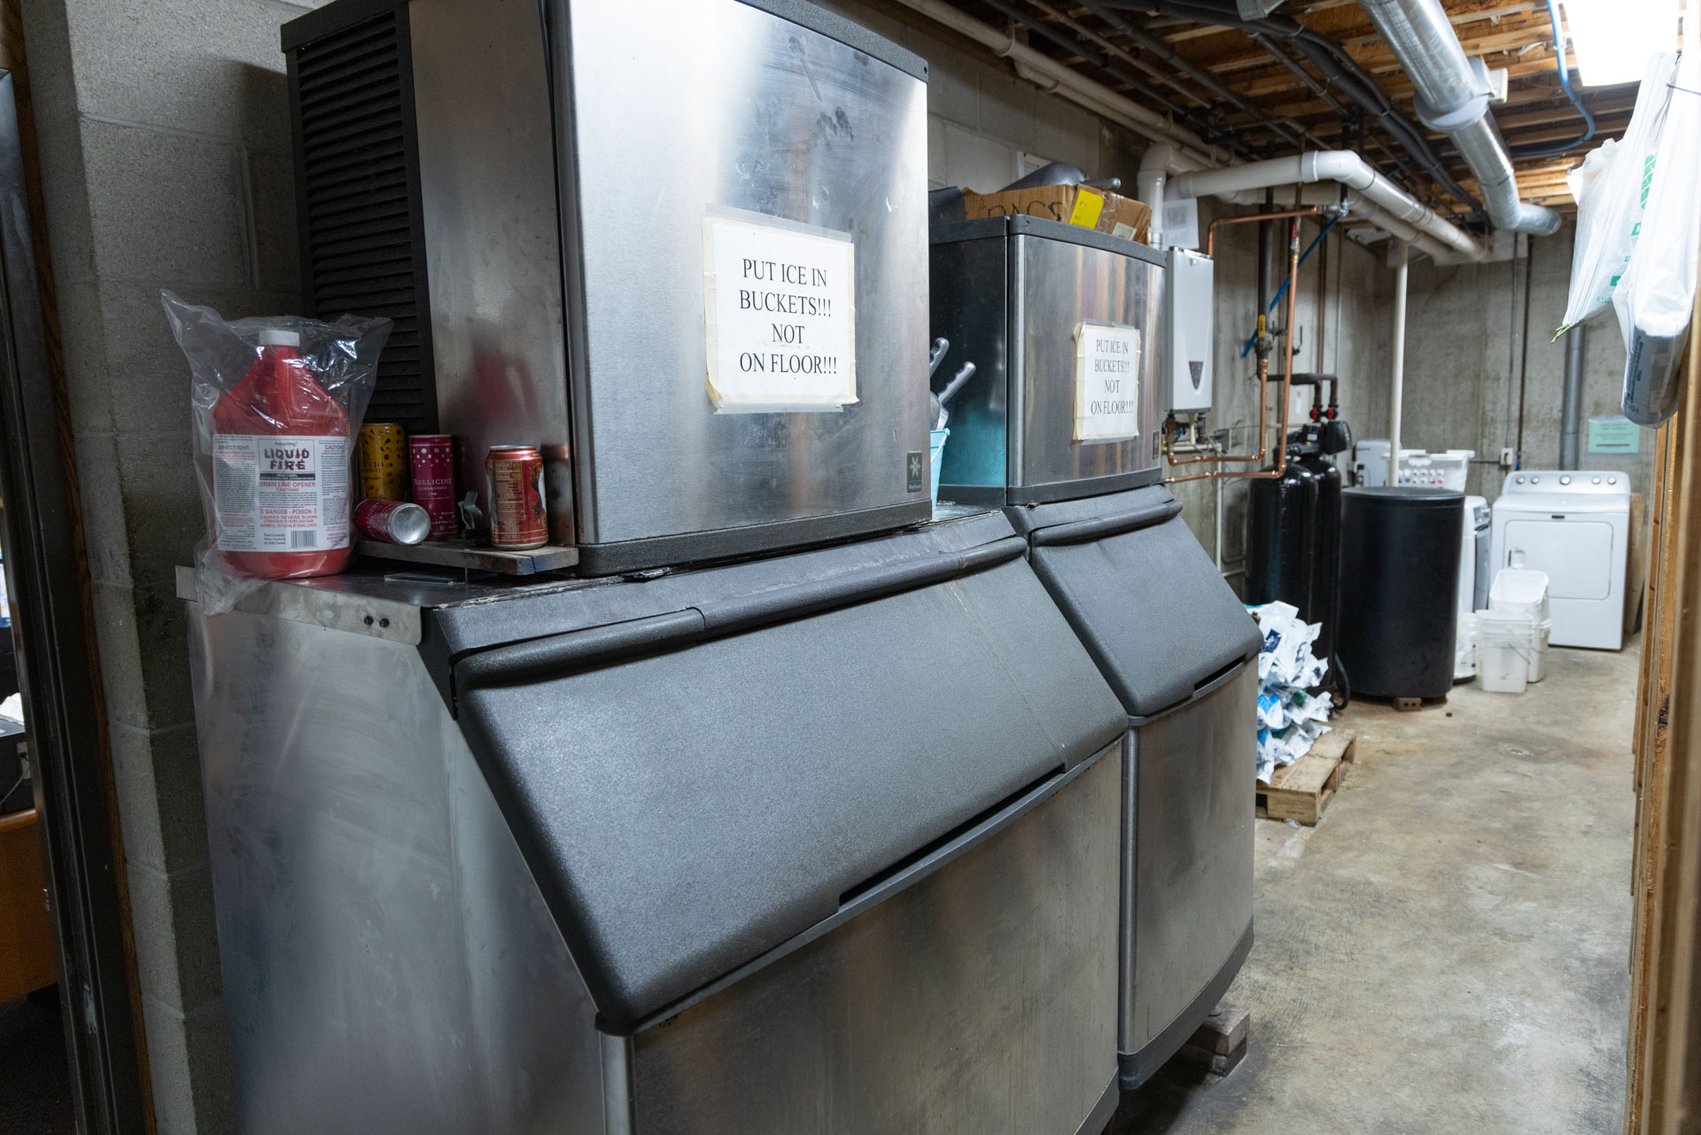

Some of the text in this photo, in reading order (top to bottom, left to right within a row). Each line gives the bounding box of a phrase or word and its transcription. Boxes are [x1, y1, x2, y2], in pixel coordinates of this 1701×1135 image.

[742, 258, 828, 287] PUT ICE IN
[739, 289, 832, 317] BUCKETS!!!
[772, 323, 806, 344] NOT
[1096, 339, 1129, 354] PUT ICE IN
[739, 352, 838, 375] ON FLOOR!!!
[1094, 359, 1130, 373] BUCKETS!!!
[1104, 380, 1121, 393] NOT
[1091, 400, 1134, 414] ON FLOOR!!!
[264, 448, 310, 460] LIQUID
[270, 460, 306, 470] FIRE
